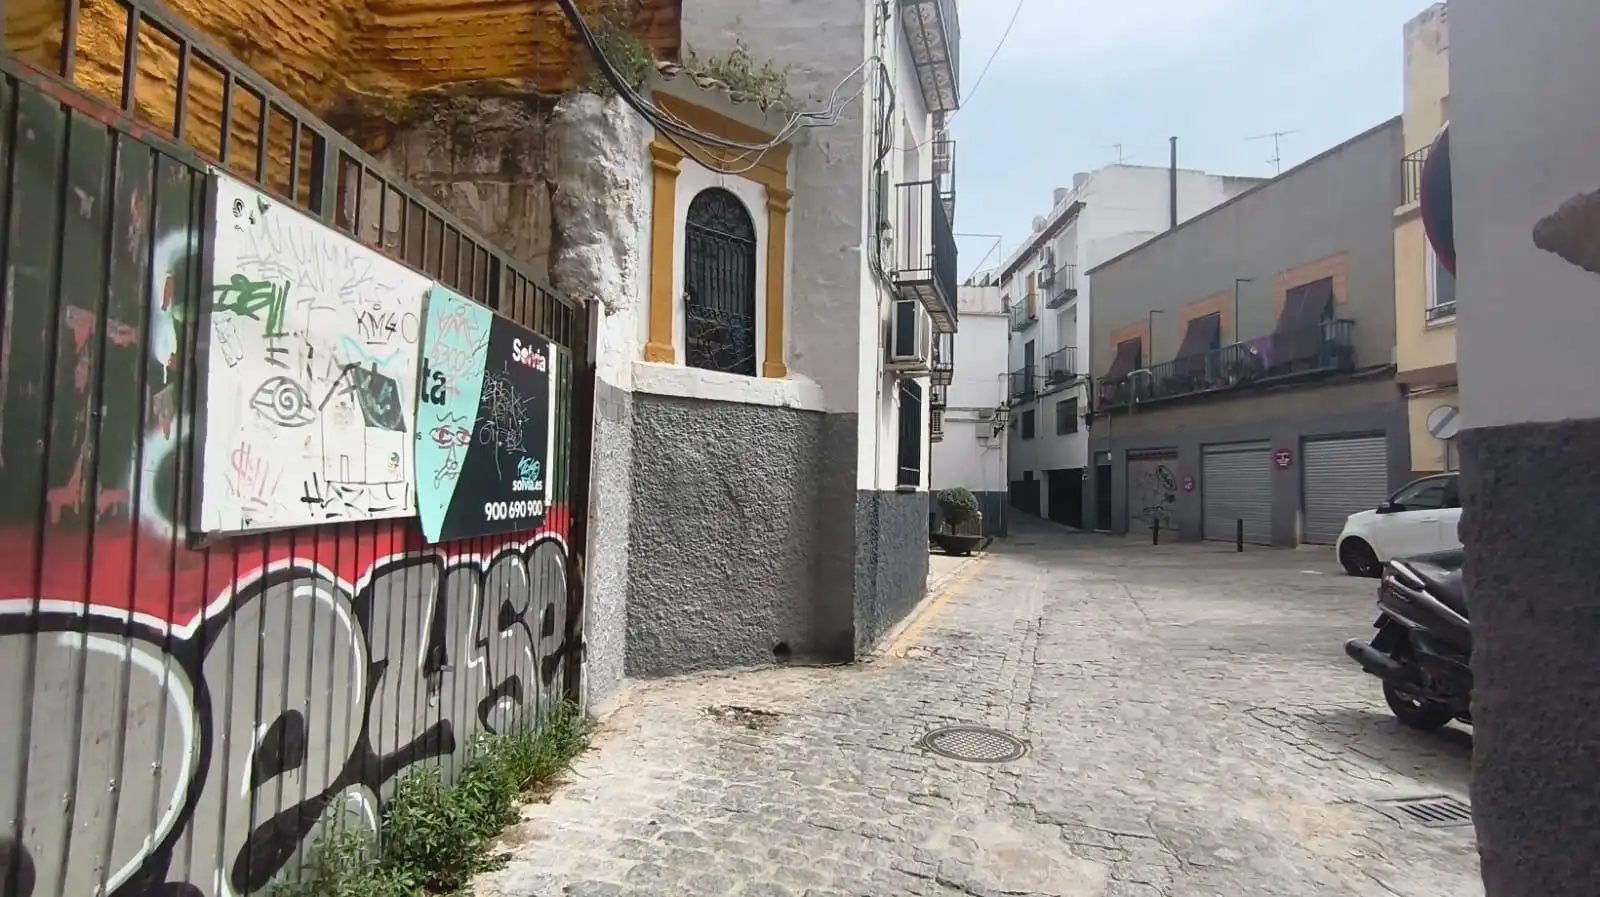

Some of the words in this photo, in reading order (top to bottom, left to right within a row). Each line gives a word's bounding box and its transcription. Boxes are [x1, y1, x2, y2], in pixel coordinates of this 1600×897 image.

[484, 501, 507, 521] 900
[508, 501, 527, 519] 690
[527, 499, 543, 517] 900
